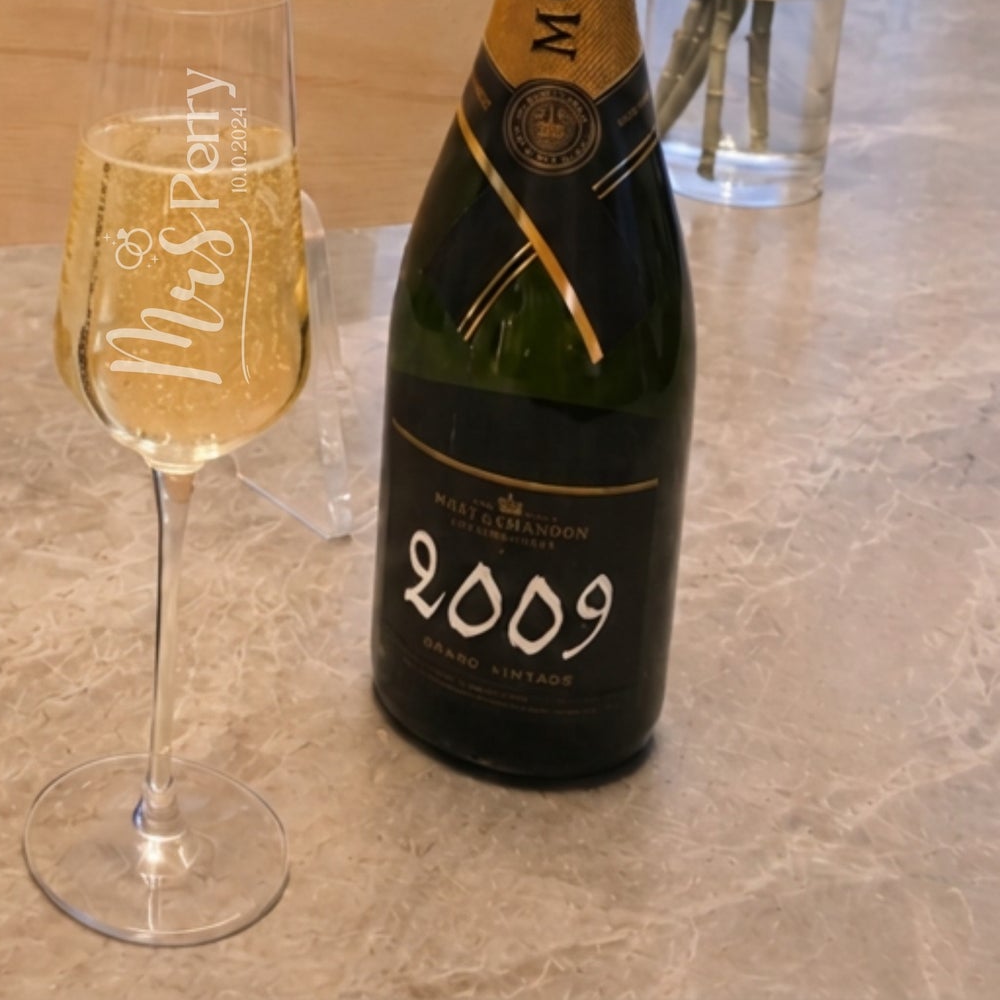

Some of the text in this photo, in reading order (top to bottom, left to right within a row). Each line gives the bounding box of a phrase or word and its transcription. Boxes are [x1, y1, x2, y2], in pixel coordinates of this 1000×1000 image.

[231, 106, 248, 194] 10.10.2024
[105, 67, 237, 385] Mrs Perry
[403, 529, 613, 660] 2009
